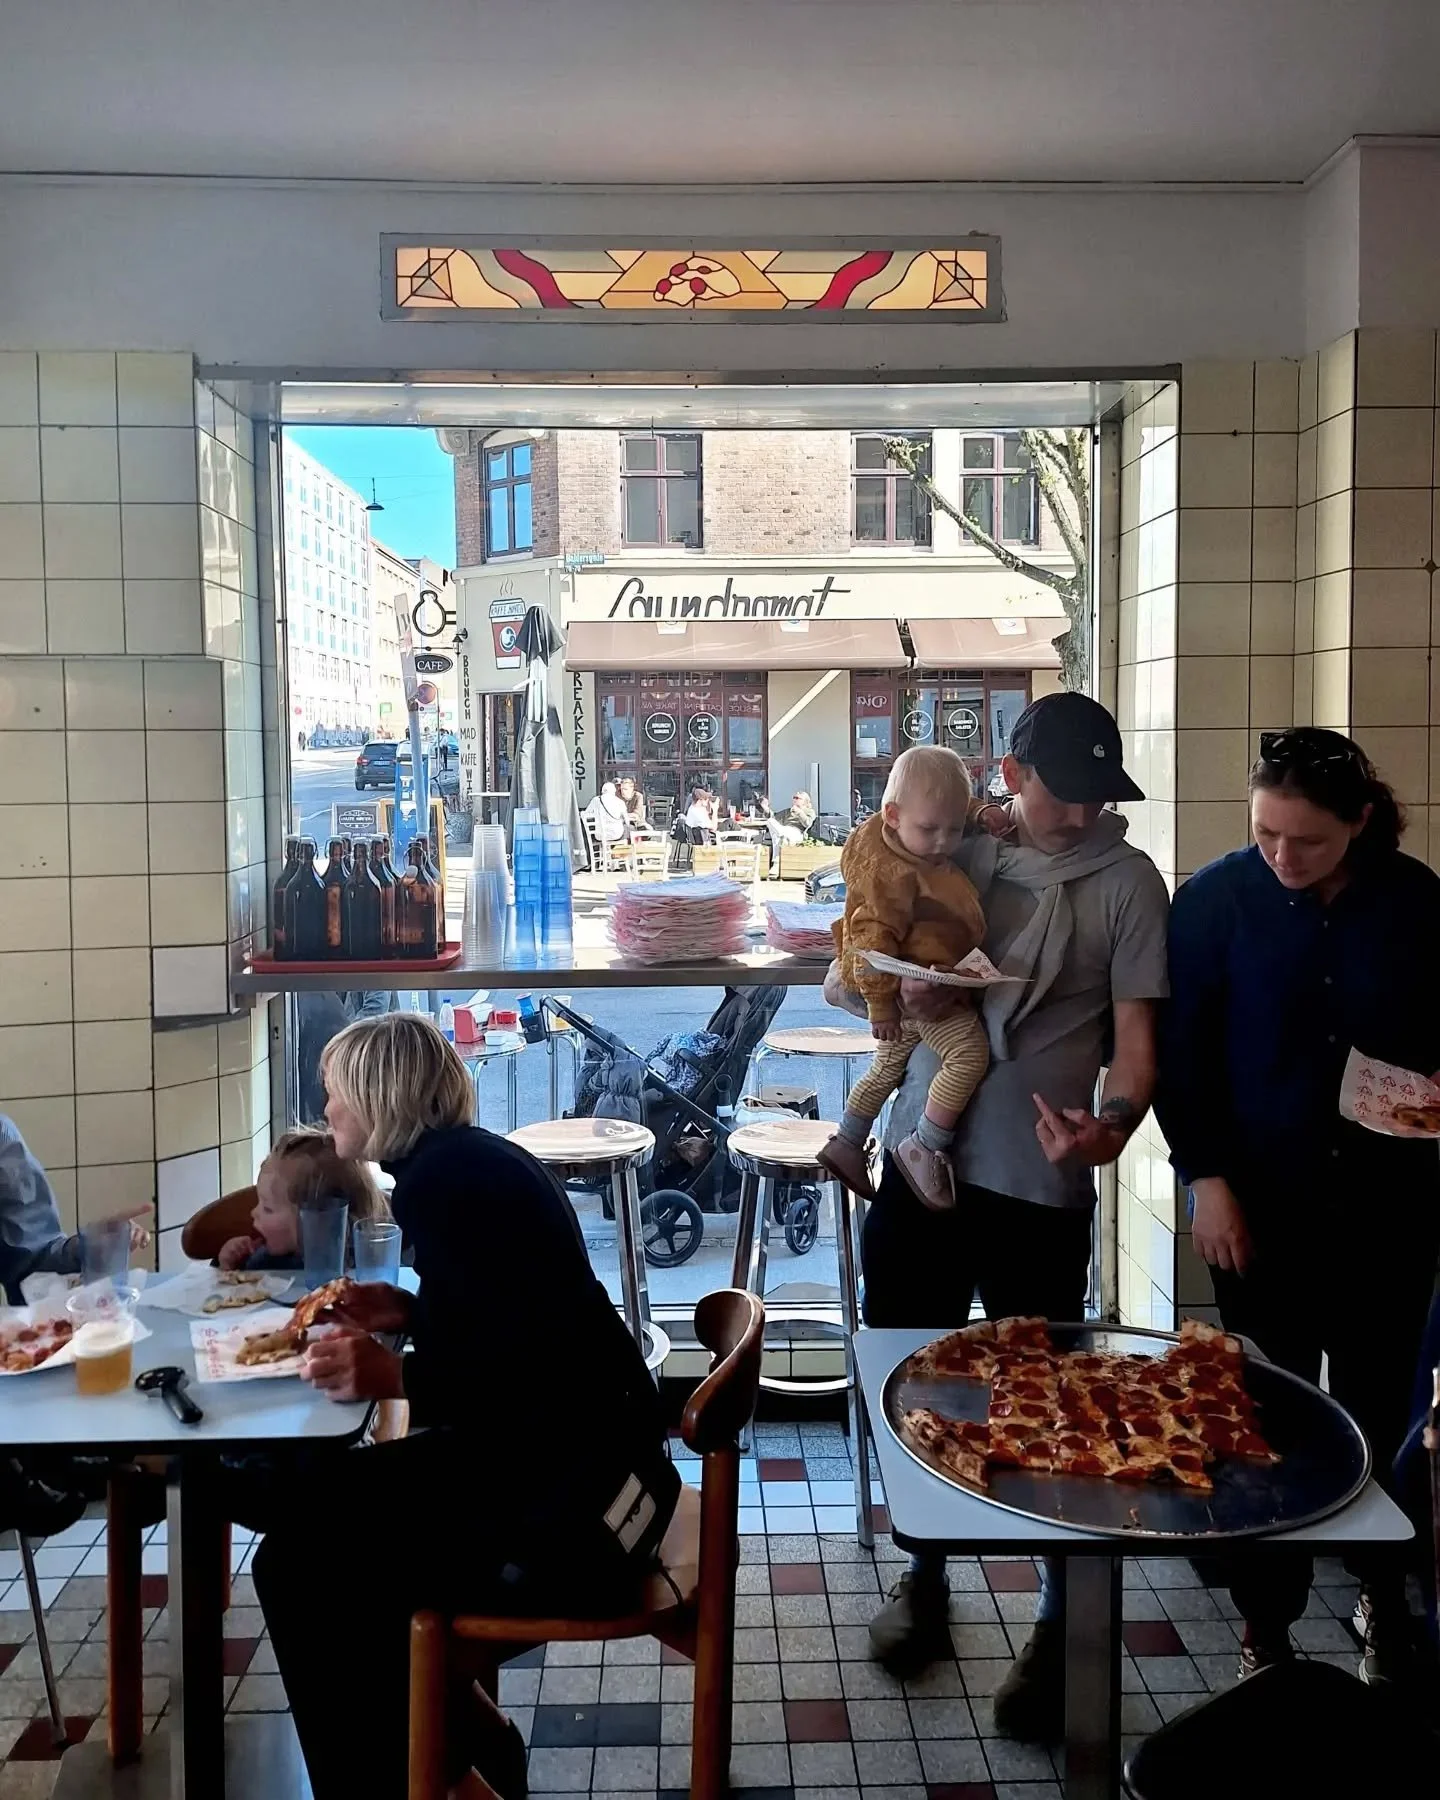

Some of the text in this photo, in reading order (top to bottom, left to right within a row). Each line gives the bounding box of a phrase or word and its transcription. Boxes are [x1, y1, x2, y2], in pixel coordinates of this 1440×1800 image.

[417, 660, 444, 671] CAFE
[463, 655, 471, 720] BRUNCH
[460, 728, 476, 740] MAD
[461, 753, 477, 766] KAFFE
